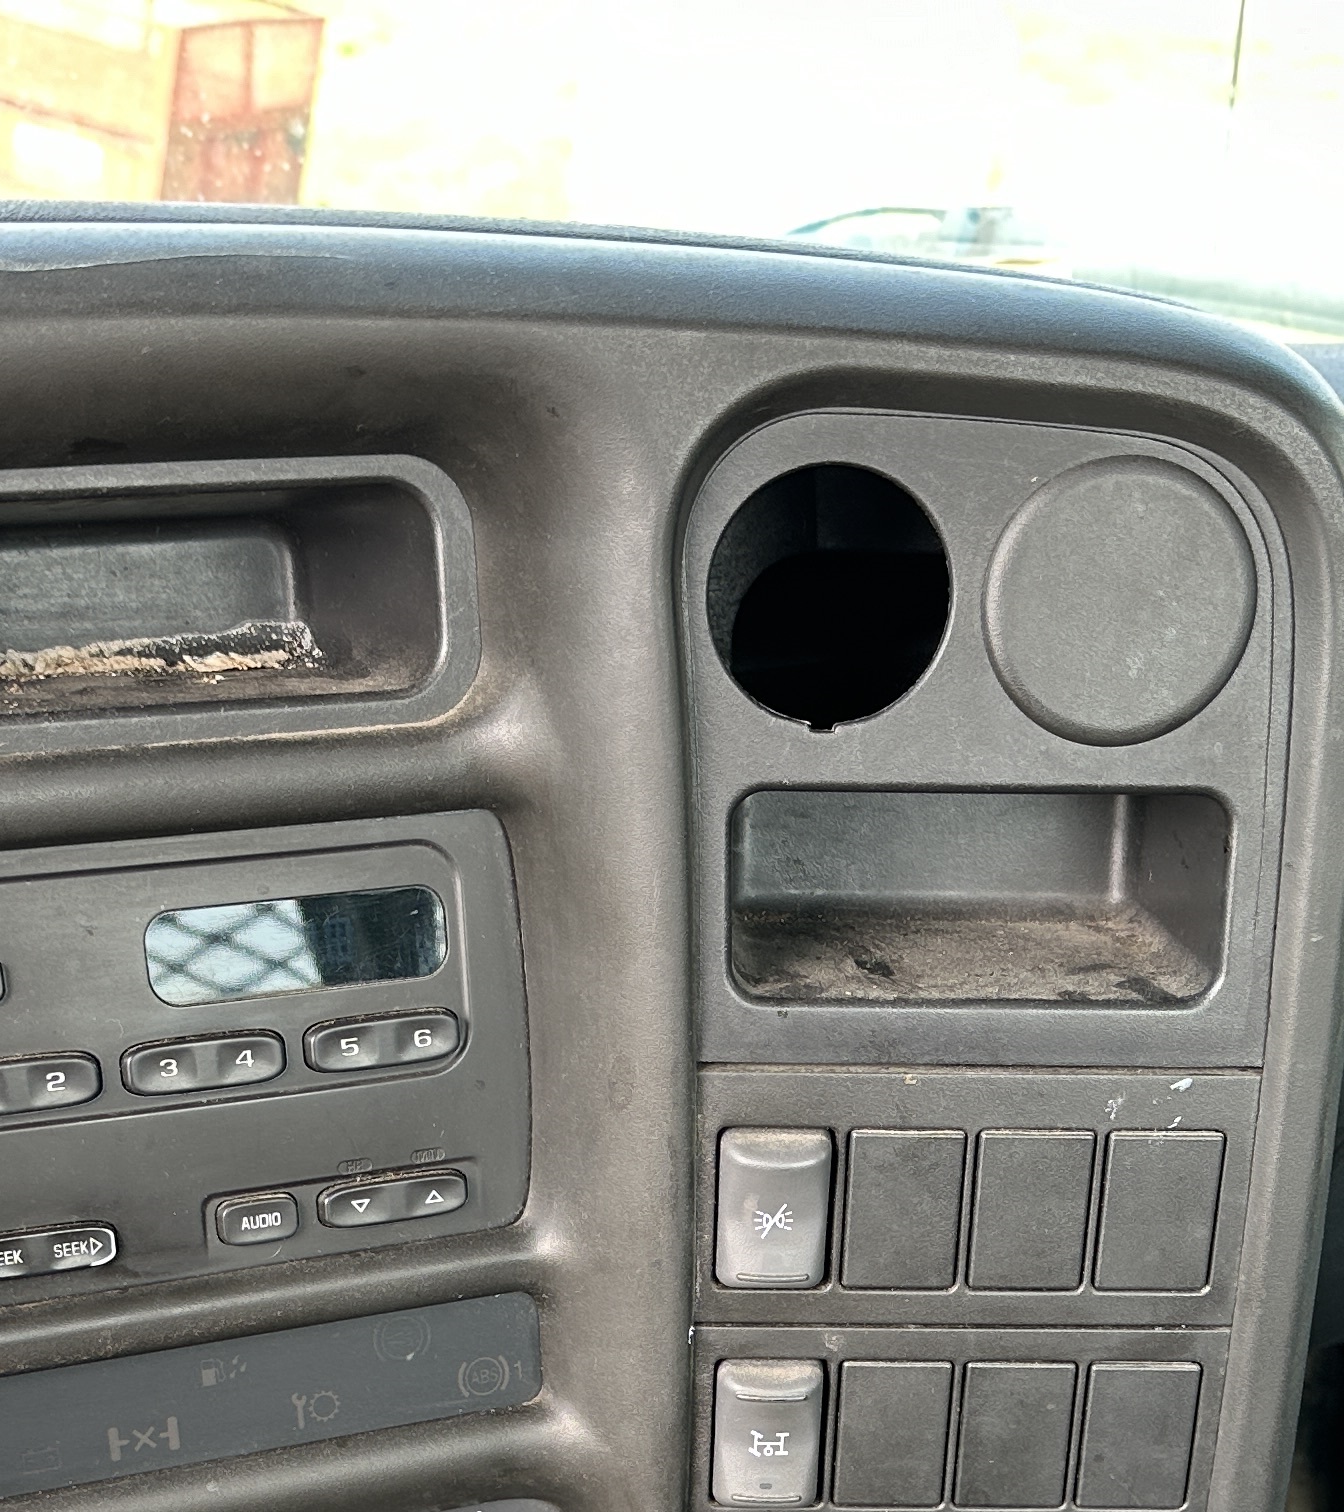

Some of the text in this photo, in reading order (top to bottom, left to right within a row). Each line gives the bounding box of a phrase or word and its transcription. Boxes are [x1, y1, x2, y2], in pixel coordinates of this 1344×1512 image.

[339, 1037, 361, 1057] 5
[412, 1029, 433, 1048] 6
[159, 1058, 179, 1078] 3
[235, 1049, 255, 1068] 4
[45, 1071, 67, 1093] 2
[240, 1211, 282, 1231] AUDIO
[53, 1239, 89, 1259] SEEK
[471, 1367, 499, 1385] ABS
